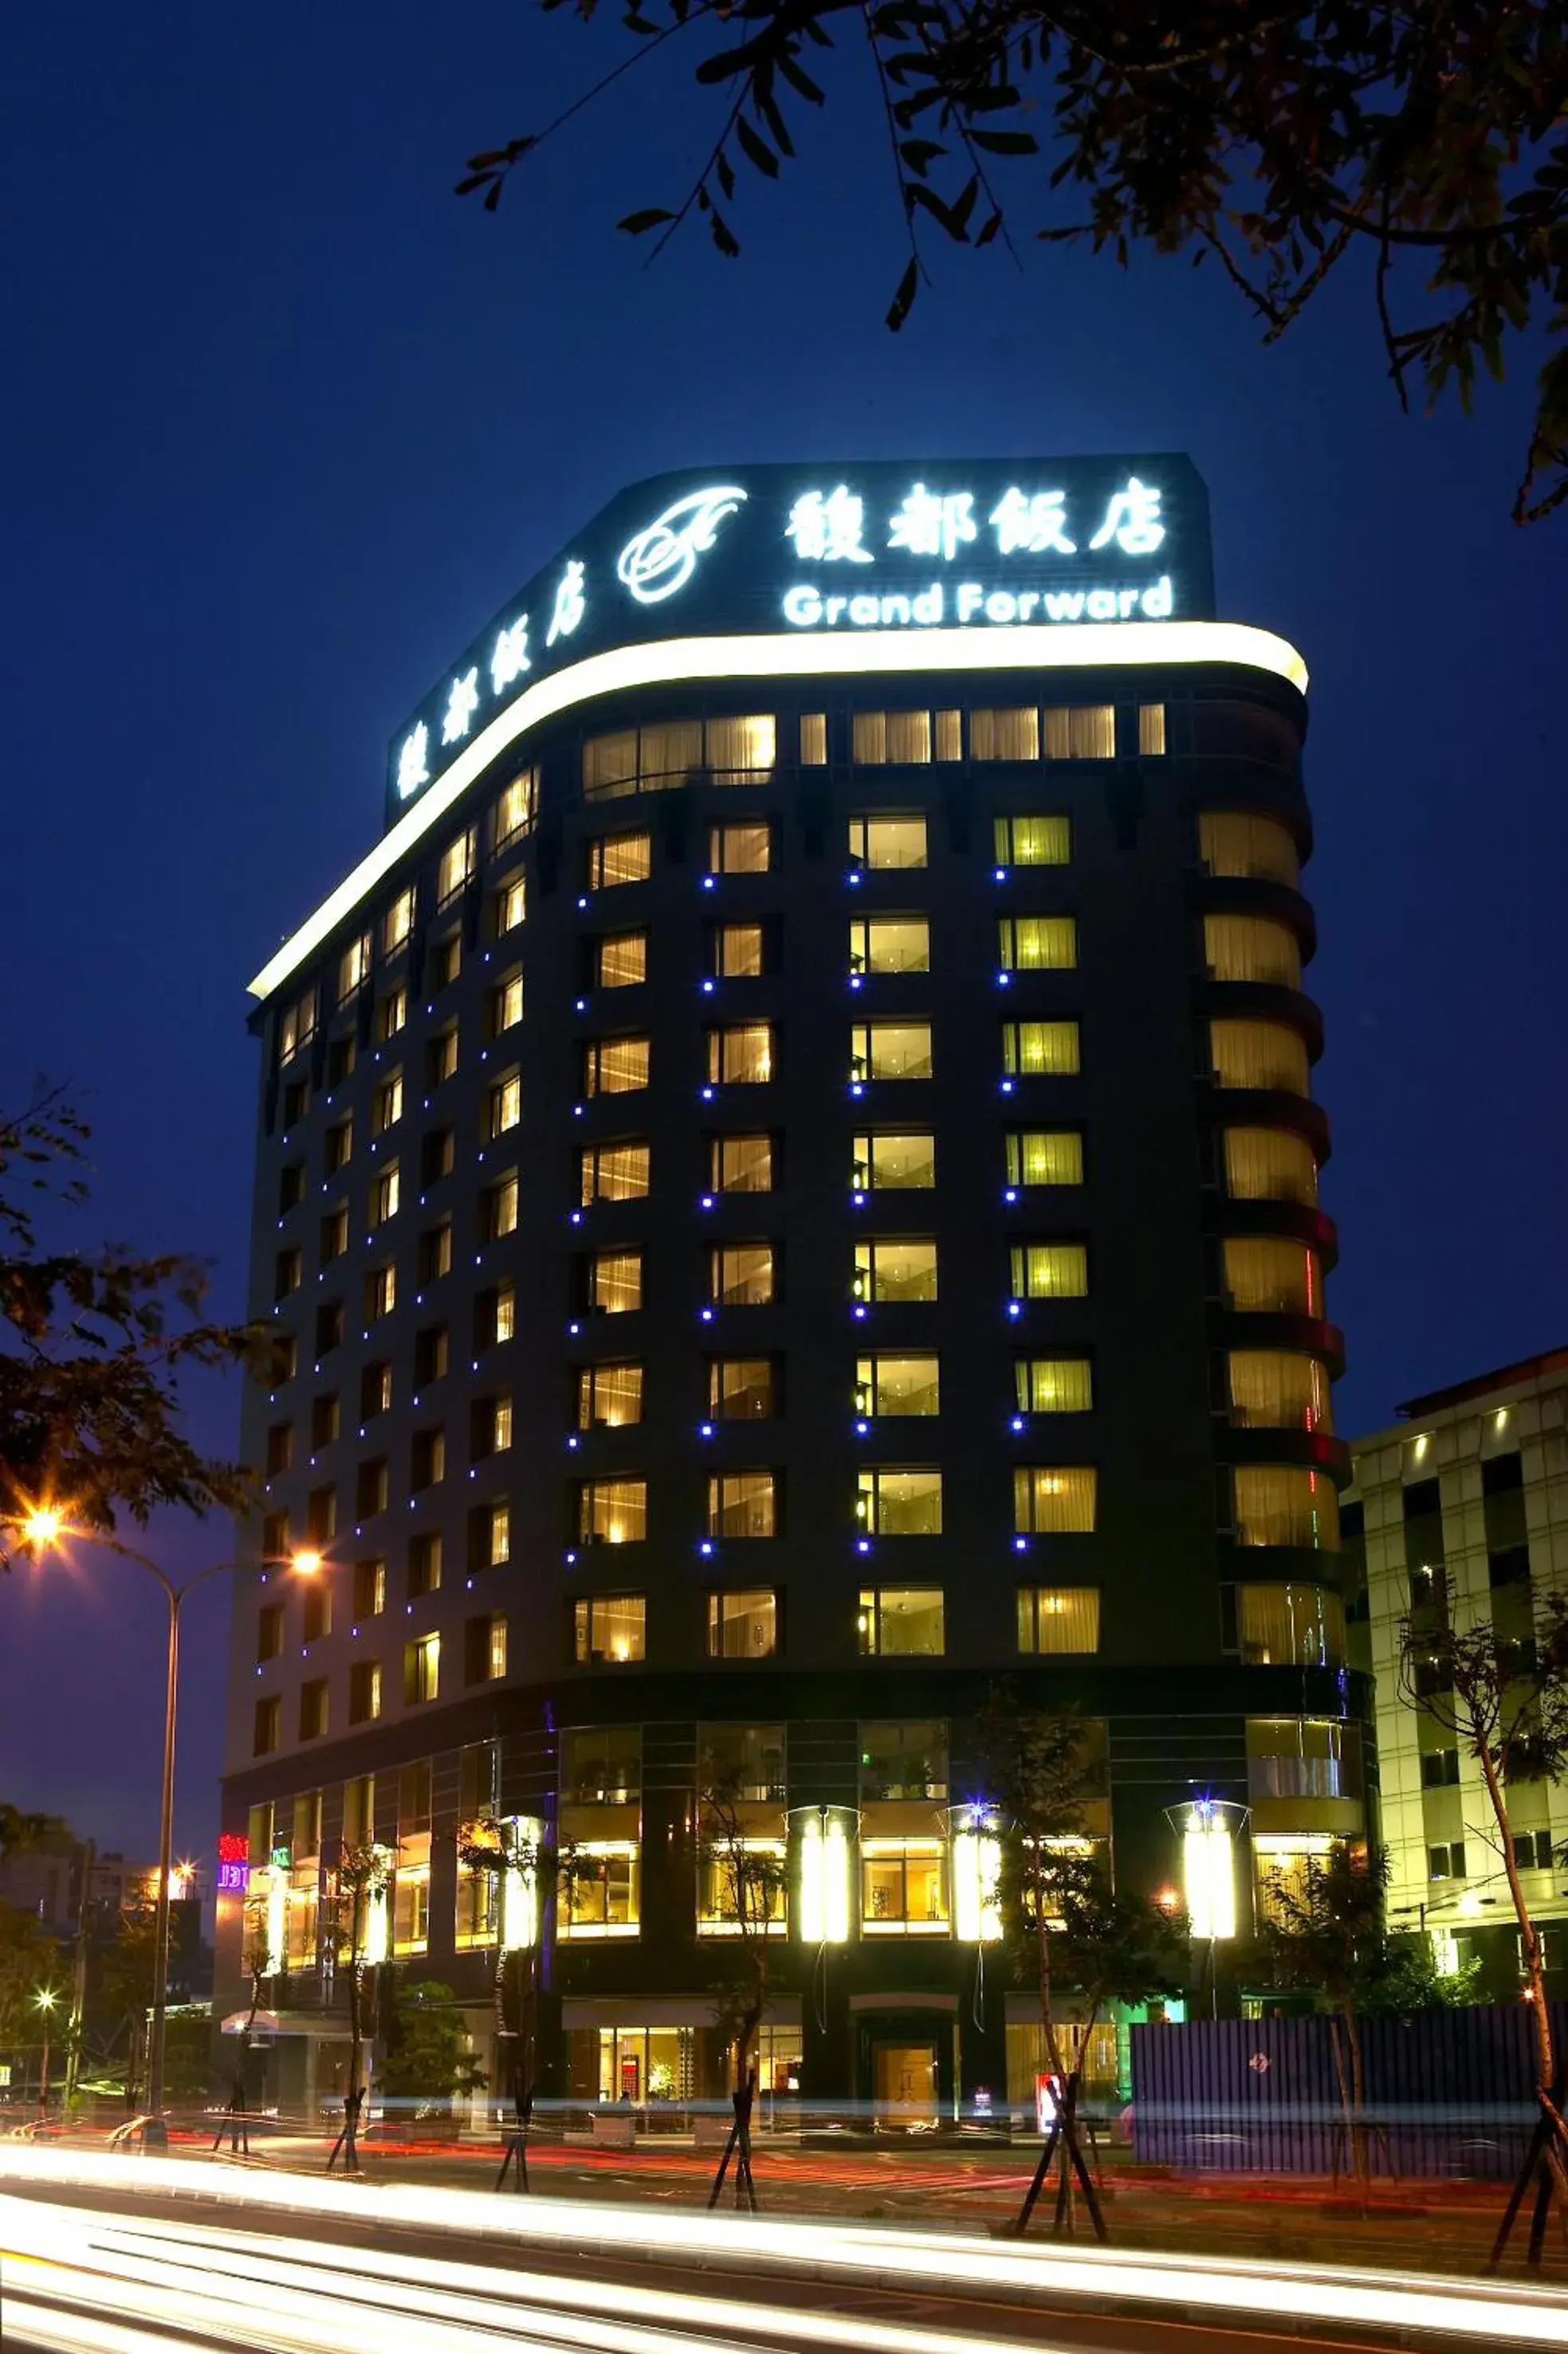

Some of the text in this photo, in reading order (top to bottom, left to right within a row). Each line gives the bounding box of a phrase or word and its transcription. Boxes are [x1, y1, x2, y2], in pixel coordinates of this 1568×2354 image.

[784, 477, 1165, 563] 馥都飯店
[782, 576, 1173, 626] Grand Forward
